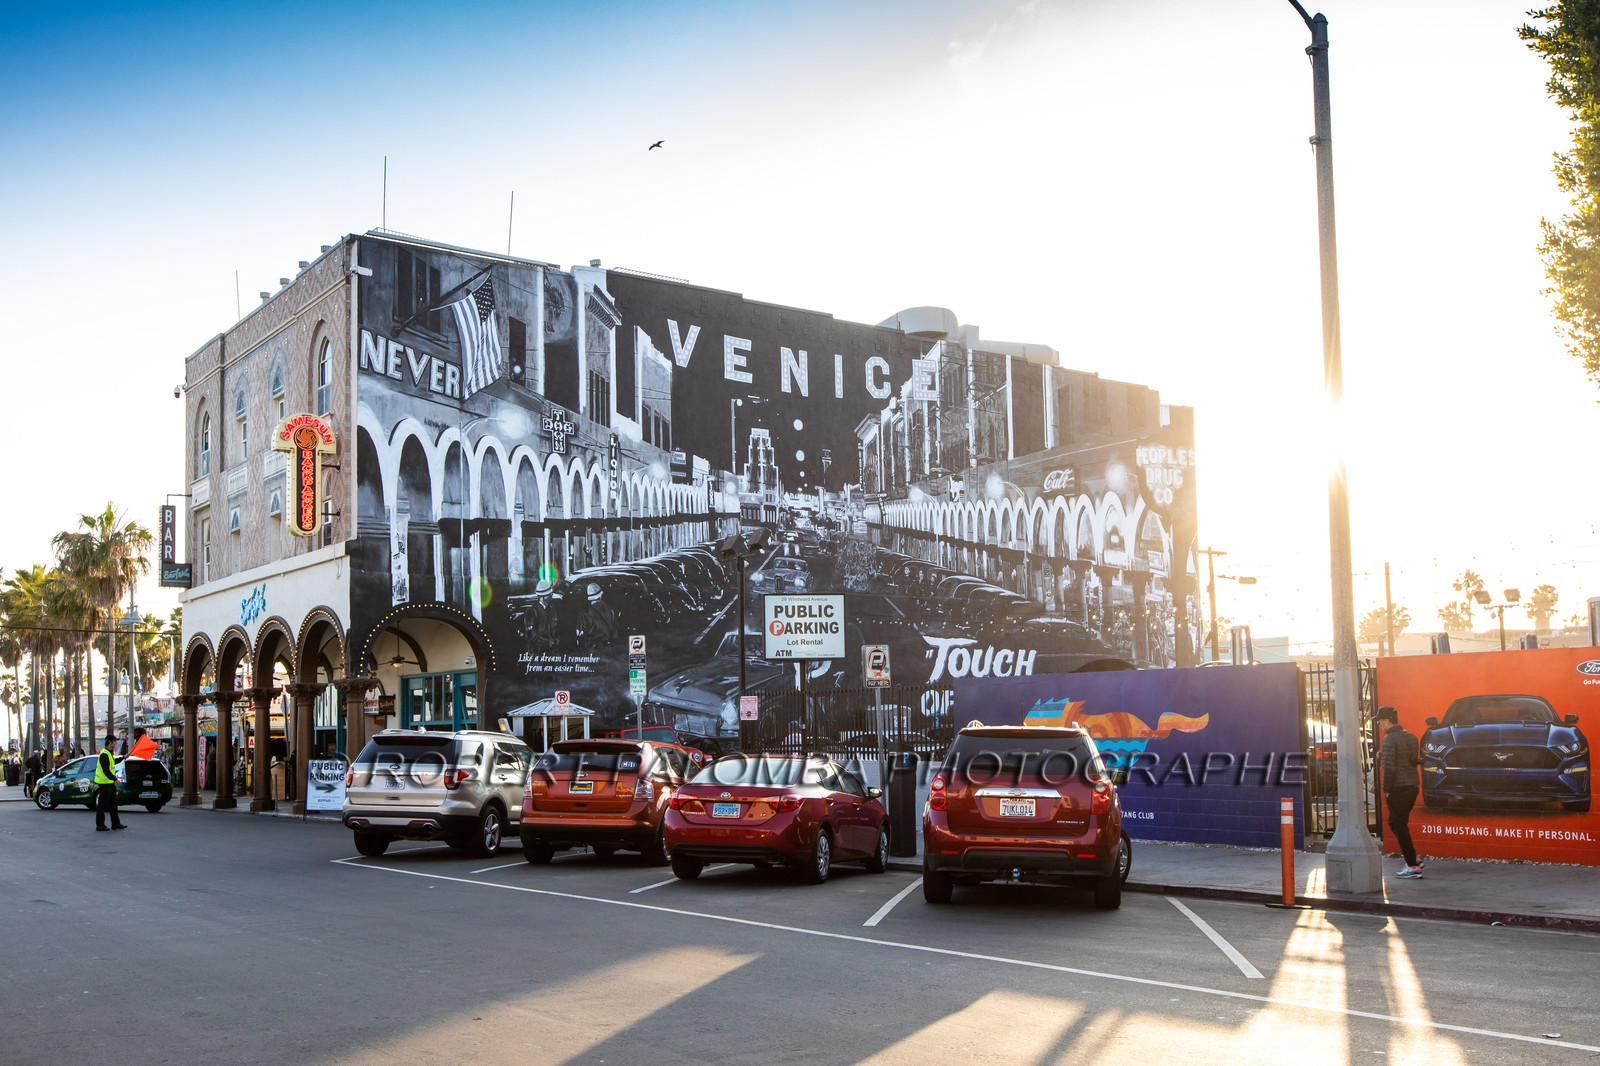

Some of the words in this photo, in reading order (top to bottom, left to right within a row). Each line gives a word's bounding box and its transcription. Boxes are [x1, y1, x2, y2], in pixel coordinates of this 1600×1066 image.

[360, 329, 460, 399] NEVER
[667, 319, 939, 401] VENICE
[281, 416, 333, 444] SAMESUN
[1146, 467, 1183, 487] DRUG
[302, 450, 313, 529] BACKPACKERS
[1154, 488, 1173, 504] CO
[164, 509, 173, 559] BAR
[774, 604, 834, 619] PUBLIC
[772, 621, 839, 636] PARKING
[518, 652, 533, 662] Like
[540, 652, 561, 662] dream
[568, 653, 600, 664] remember
[525, 662, 542, 675] from
[554, 664, 573, 673] easier
[311, 762, 344, 771] PUBLIC
[310, 773, 345, 782] PARKING
[1422, 825, 1442, 834] 2018
[1445, 826, 1492, 837] MUSTANG.
[1495, 828, 1521, 838] MAKE
[1525, 830, 1535, 839] IT
[1538, 831, 1596, 842] PERSONAL.
